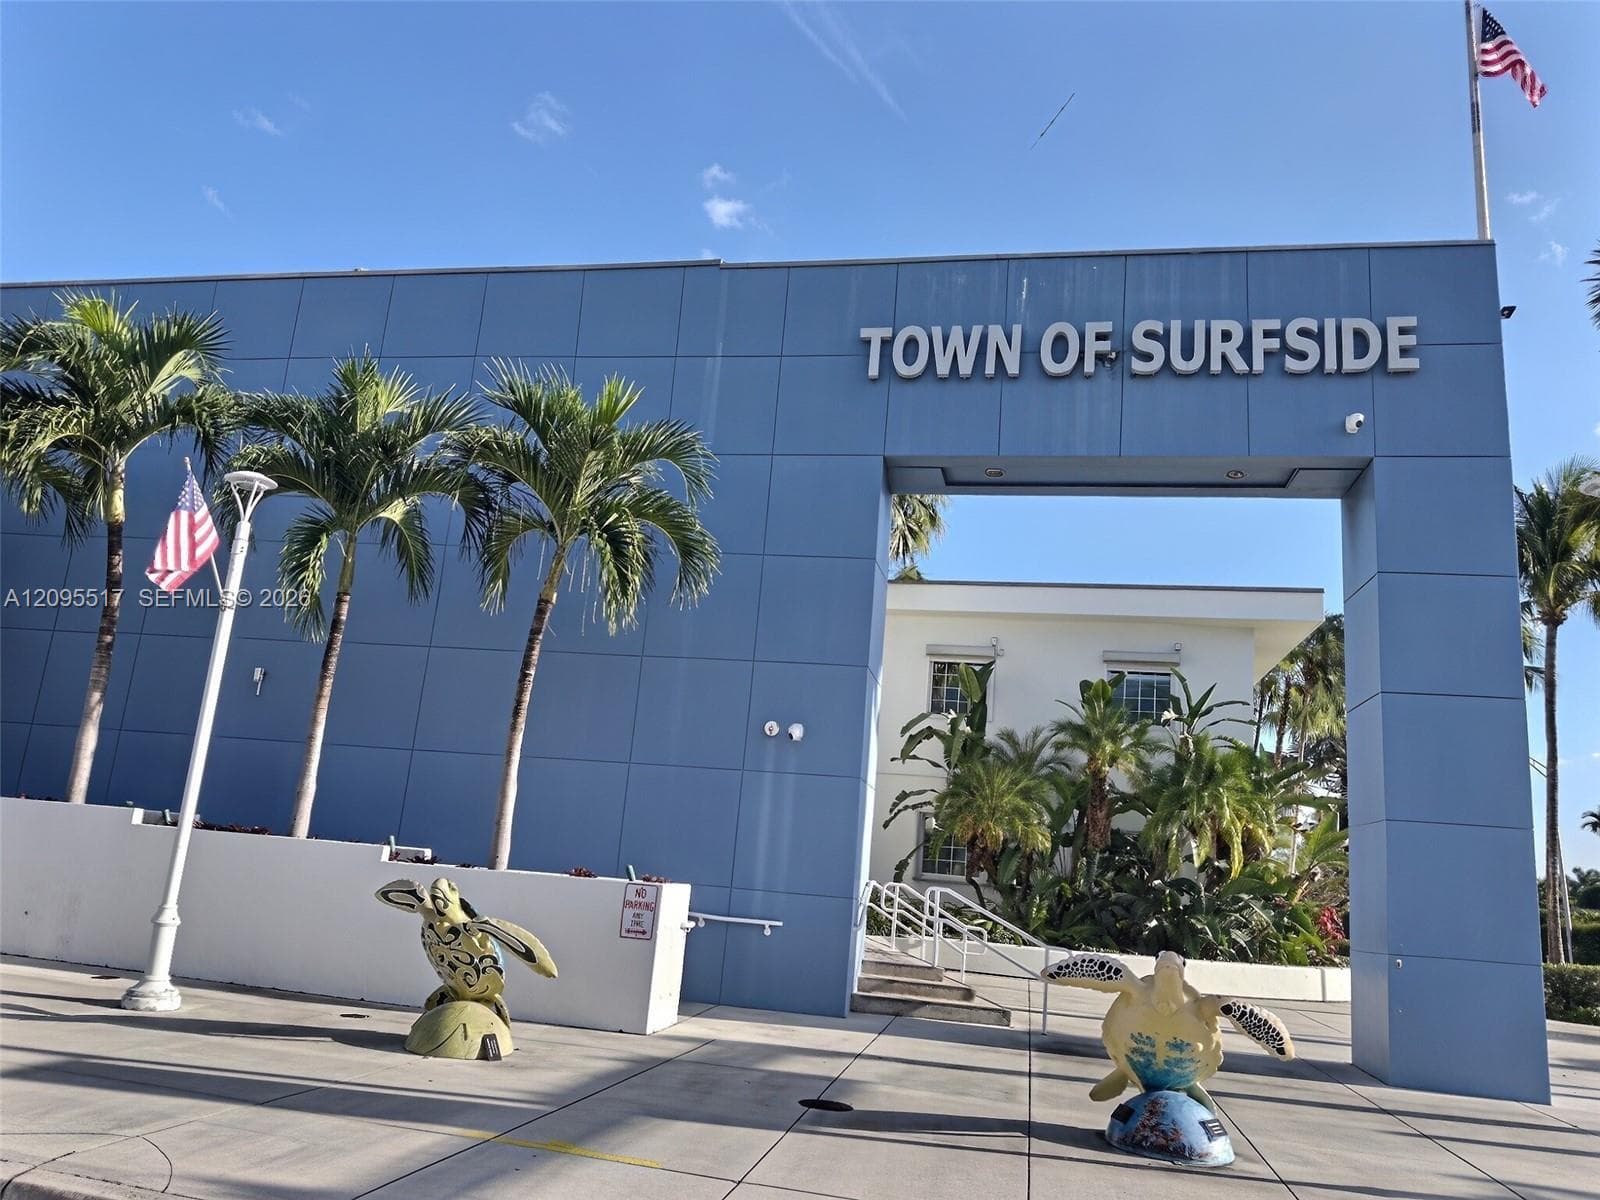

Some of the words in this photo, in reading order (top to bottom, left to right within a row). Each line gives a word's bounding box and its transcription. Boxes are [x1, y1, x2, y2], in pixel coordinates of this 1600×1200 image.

[859, 323, 1022, 380] TOWN
[1040, 321, 1114, 378] OF
[1130, 315, 1421, 377] SURFSIDE
[635, 887, 647, 899] NO
[624, 899, 656, 912] PARKING
